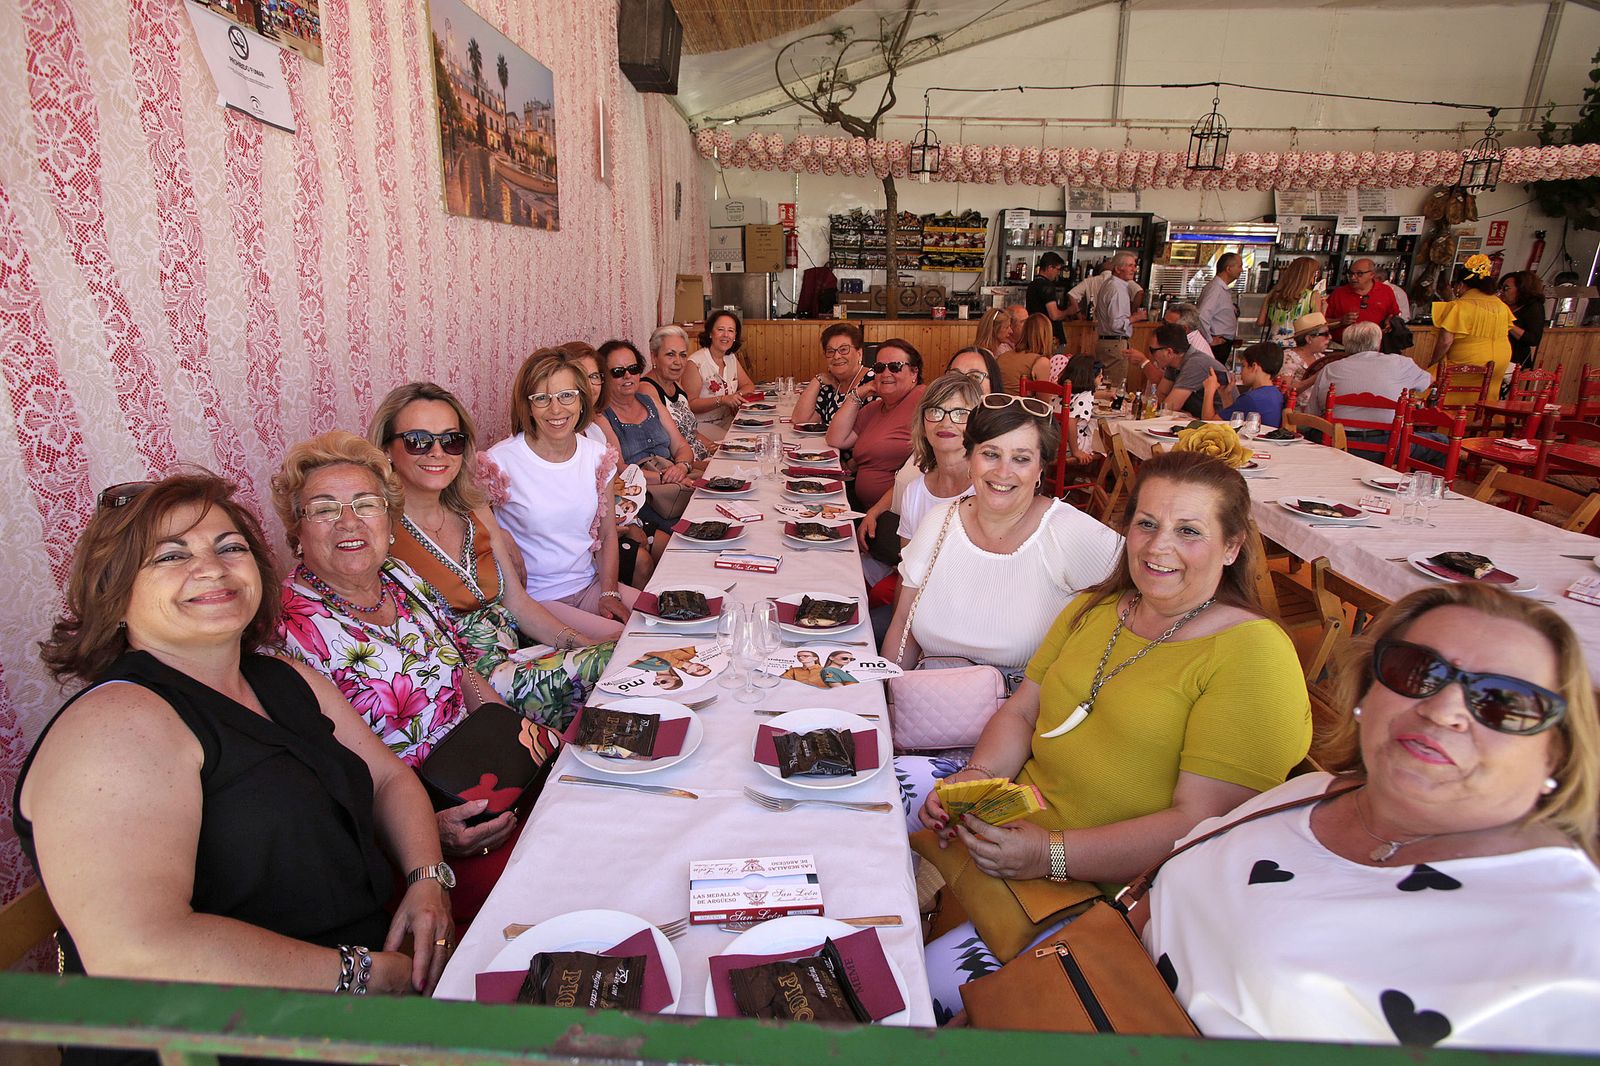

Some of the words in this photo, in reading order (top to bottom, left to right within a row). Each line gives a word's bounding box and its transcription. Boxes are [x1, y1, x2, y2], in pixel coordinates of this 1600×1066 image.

[706, 891, 741, 899] MEDALLAS
[771, 890, 792, 898] San
[729, 910, 753, 921] San
[757, 909, 784, 919] León
